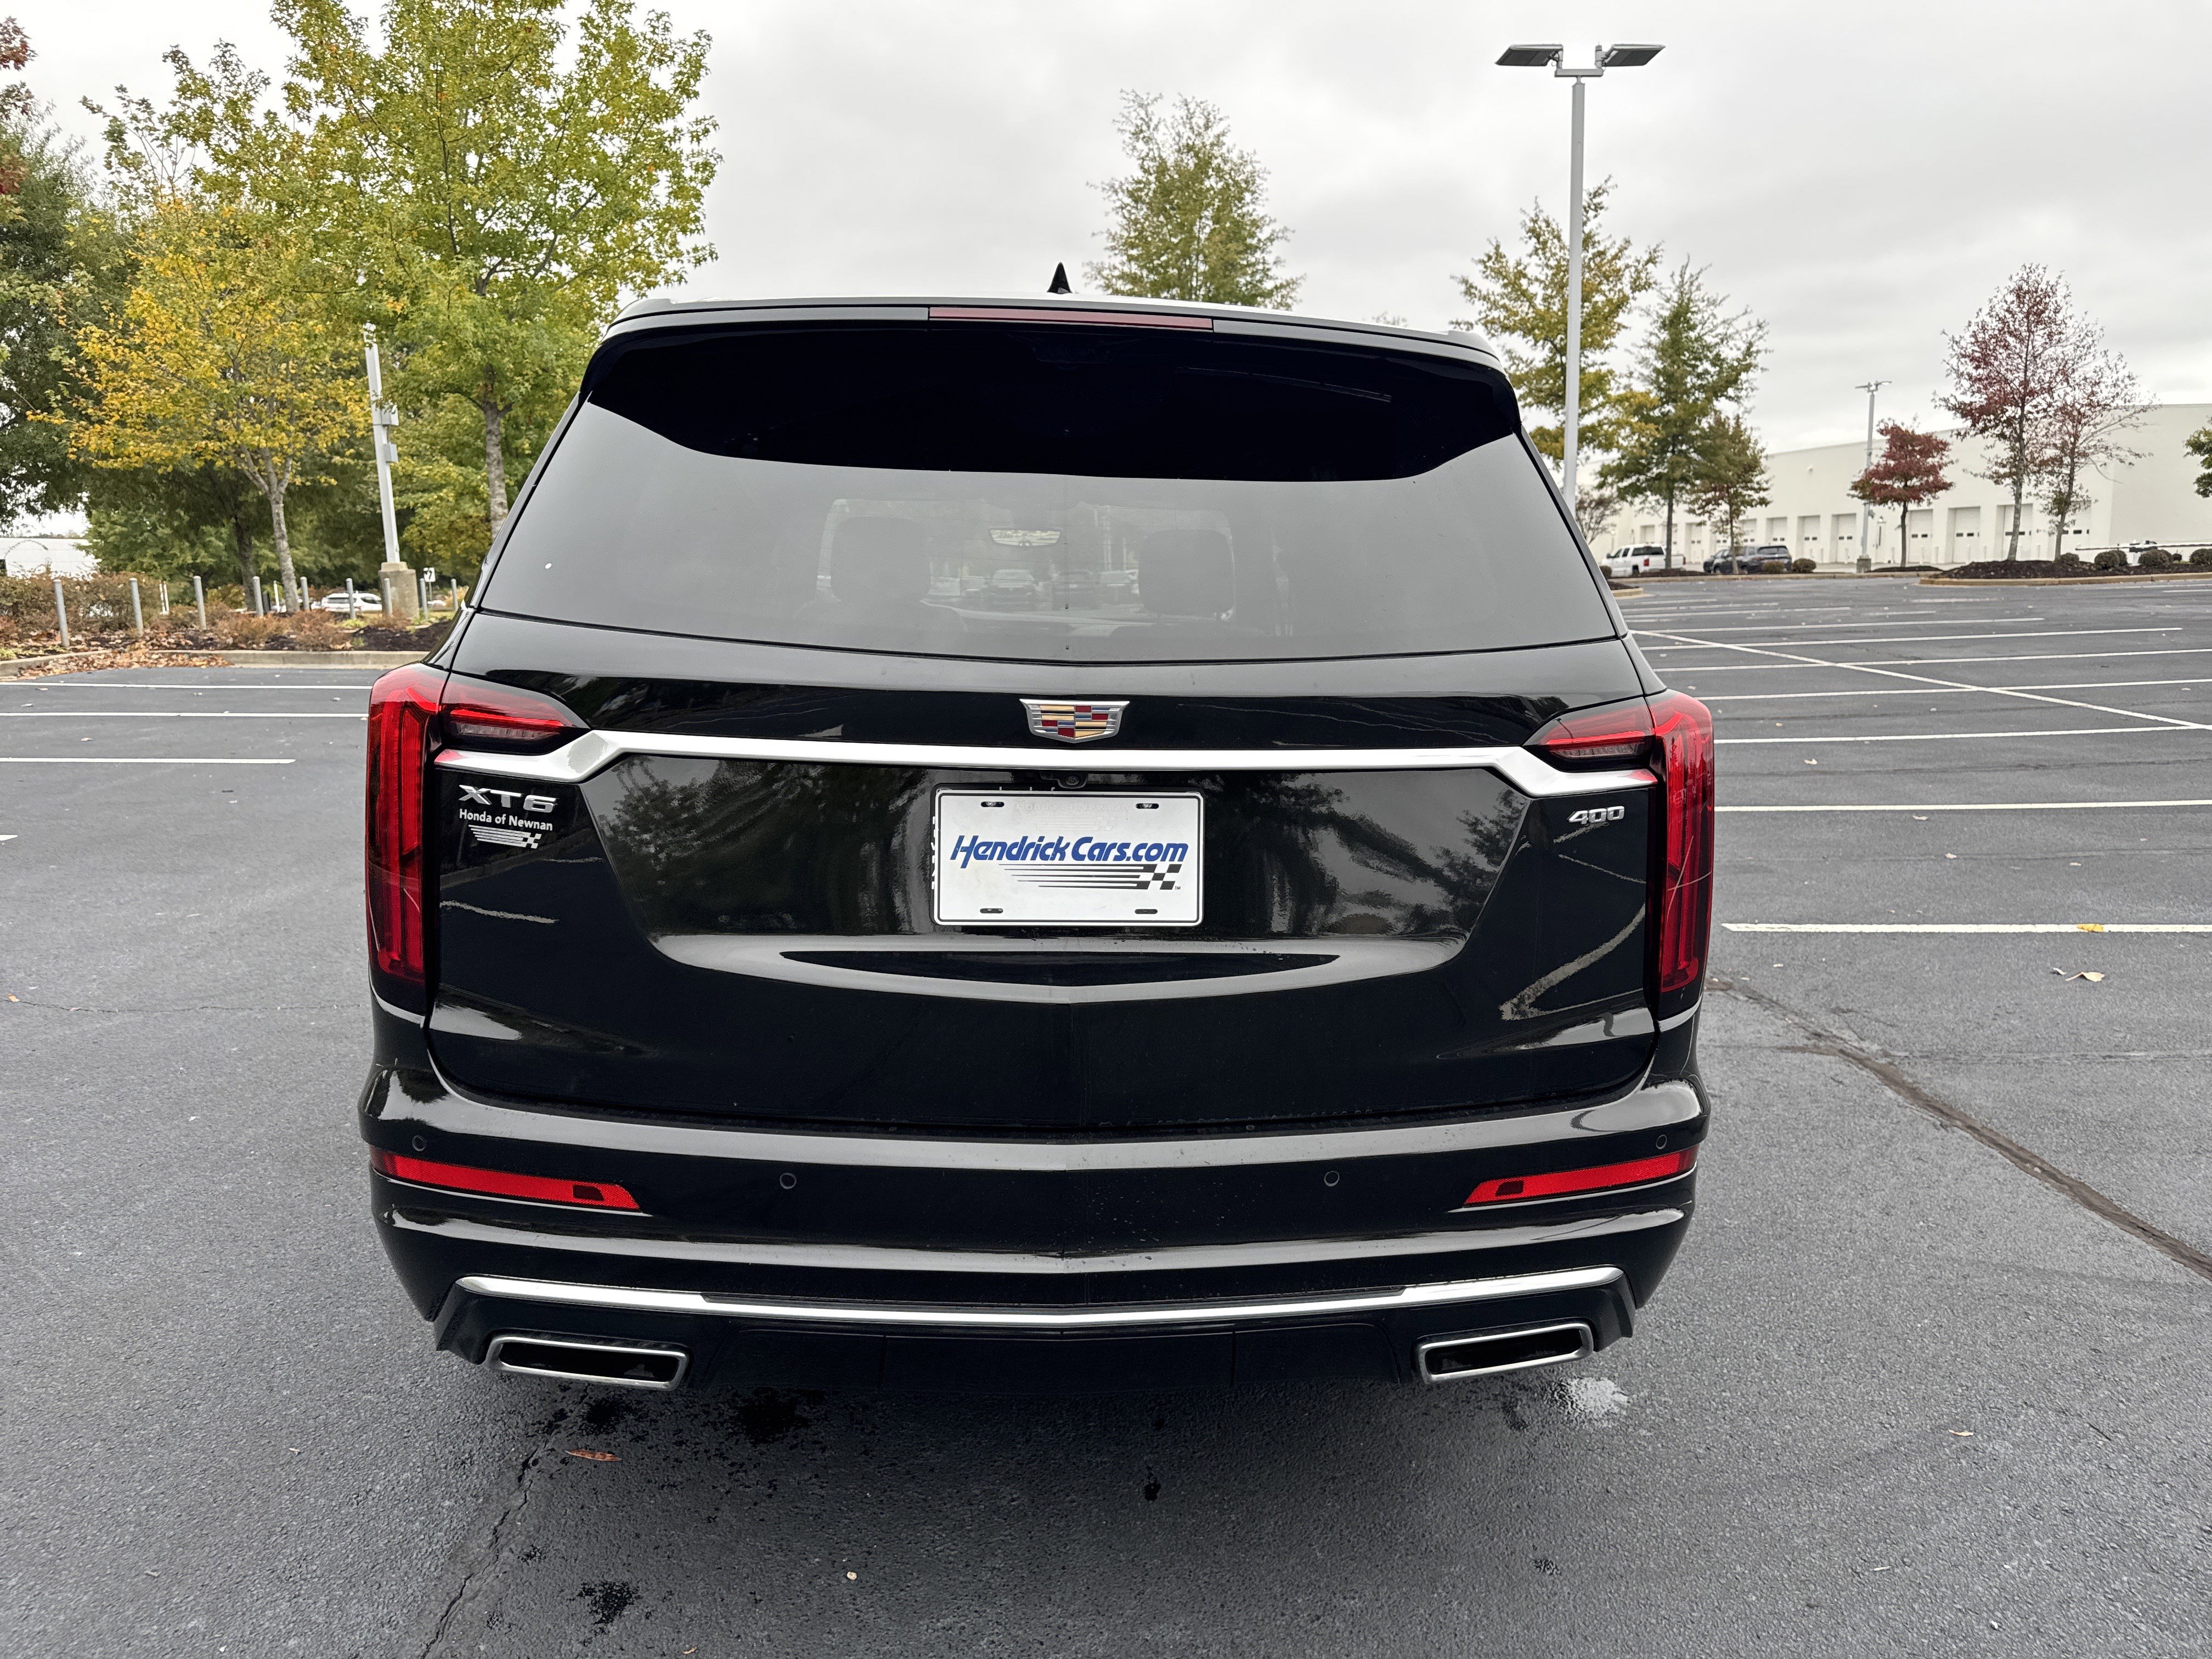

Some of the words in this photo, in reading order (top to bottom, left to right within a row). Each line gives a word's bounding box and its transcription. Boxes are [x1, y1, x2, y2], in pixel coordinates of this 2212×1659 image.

[459, 785, 557, 813] XT6
[459, 809, 492, 823] Honda
[495, 814, 506, 825] of
[509, 815, 553, 831] Newnan
[1567, 806, 1624, 824] 400
